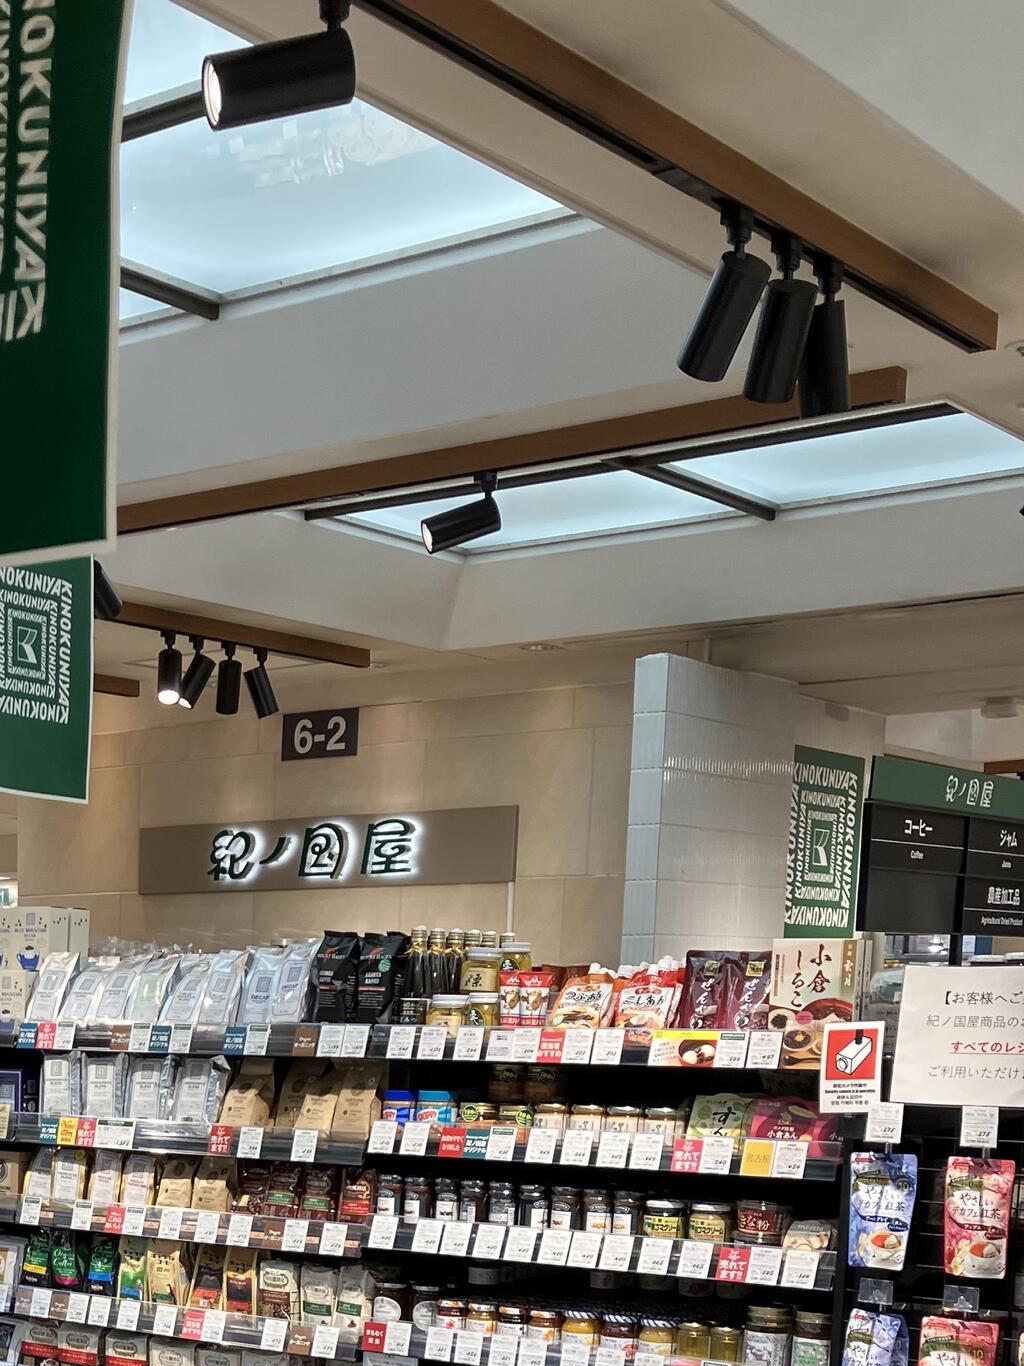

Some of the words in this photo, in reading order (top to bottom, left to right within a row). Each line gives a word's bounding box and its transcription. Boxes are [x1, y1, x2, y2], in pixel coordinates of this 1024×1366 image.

[58, 580, 73, 706] KINOKUNIYA
[293, 715, 347, 754] 6-2
[904, 818, 933, 838] コーヒー
[999, 829, 1018, 848] ジャム
[910, 850, 924, 860] Coffee
[987, 886, 1021, 906] 農産加工品
[807, 944, 832, 993] 小倉
[791, 950, 805, 1007] しるこ
[945, 990, 1024, 1006] 【お客様へご
[926, 1014, 1024, 1028] 紀ノ国屋商品の
[928, 1065, 1024, 1079] ご利用いただけ
[960, 1192, 994, 1206] やさしい
[952, 1206, 1001, 1220] デカフェ紅茶
[937, 1353, 974, 1366] やさしい
